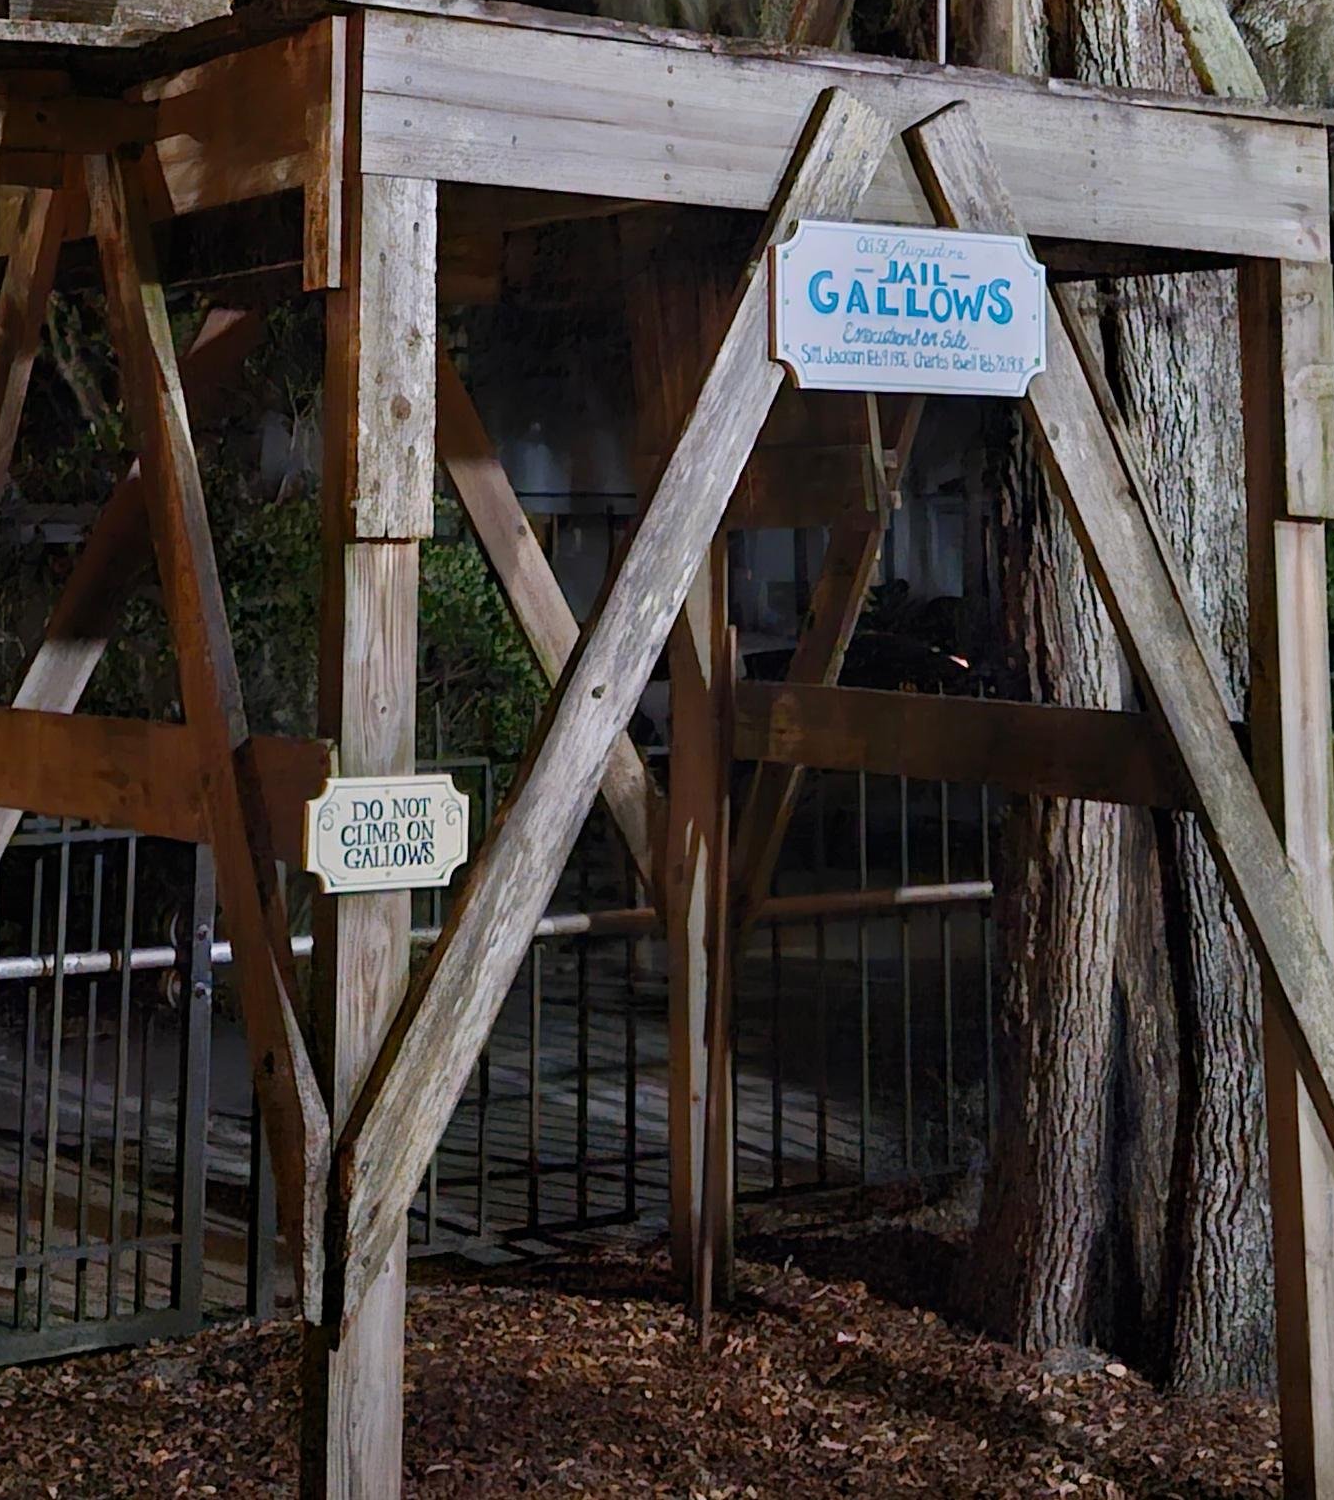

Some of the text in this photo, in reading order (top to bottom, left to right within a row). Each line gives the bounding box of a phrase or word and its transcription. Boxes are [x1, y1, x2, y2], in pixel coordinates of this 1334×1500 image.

[878, 260, 948, 286] JAIL
[808, 270, 1013, 325] GALLOWS
[921, 331, 938, 347] on
[351, 797, 432, 822] DO NOT
[340, 820, 435, 847] CLIMB ON
[343, 842, 436, 869] GALLOWS
